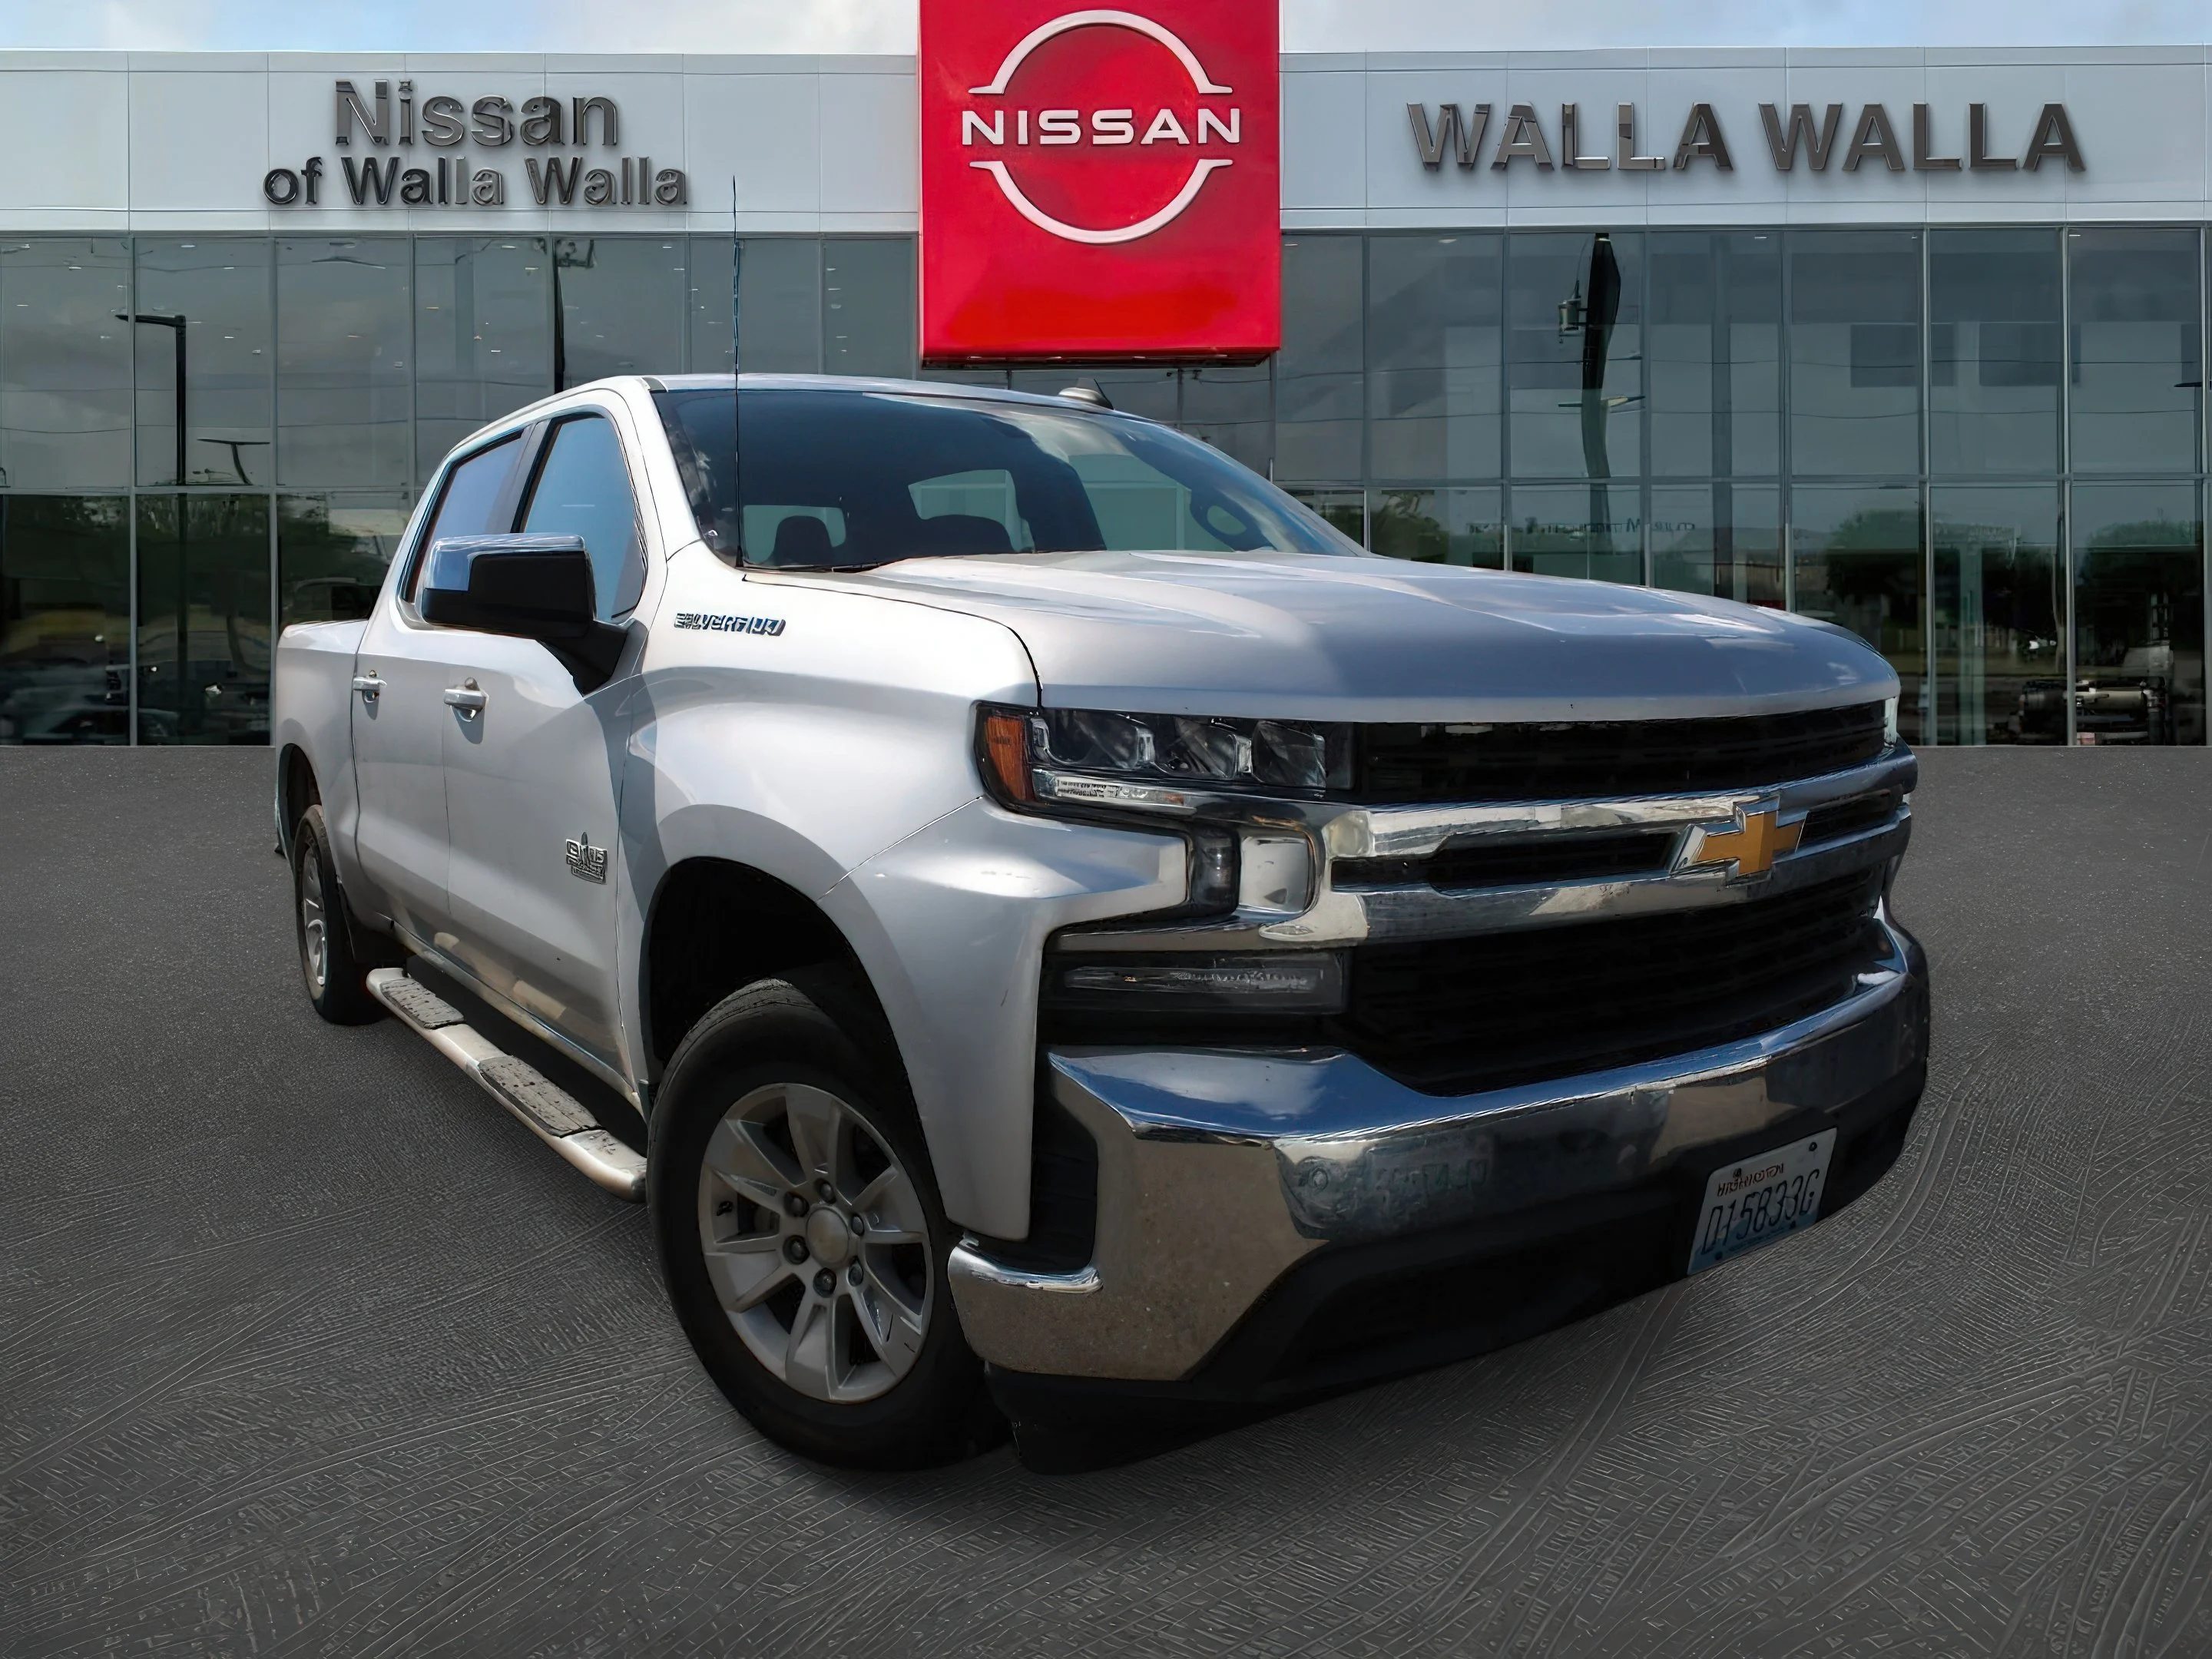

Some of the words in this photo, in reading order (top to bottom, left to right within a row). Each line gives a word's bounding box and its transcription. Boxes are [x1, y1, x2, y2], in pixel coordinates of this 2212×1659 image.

[335, 79, 618, 147] Nissan
[962, 108, 1240, 145] NISSAN
[1406, 101, 1734, 171] WALLA
[1758, 101, 2086, 172] WALLA
[262, 156, 323, 205] of
[341, 156, 505, 205] Walla
[524, 156, 687, 205] Walla
